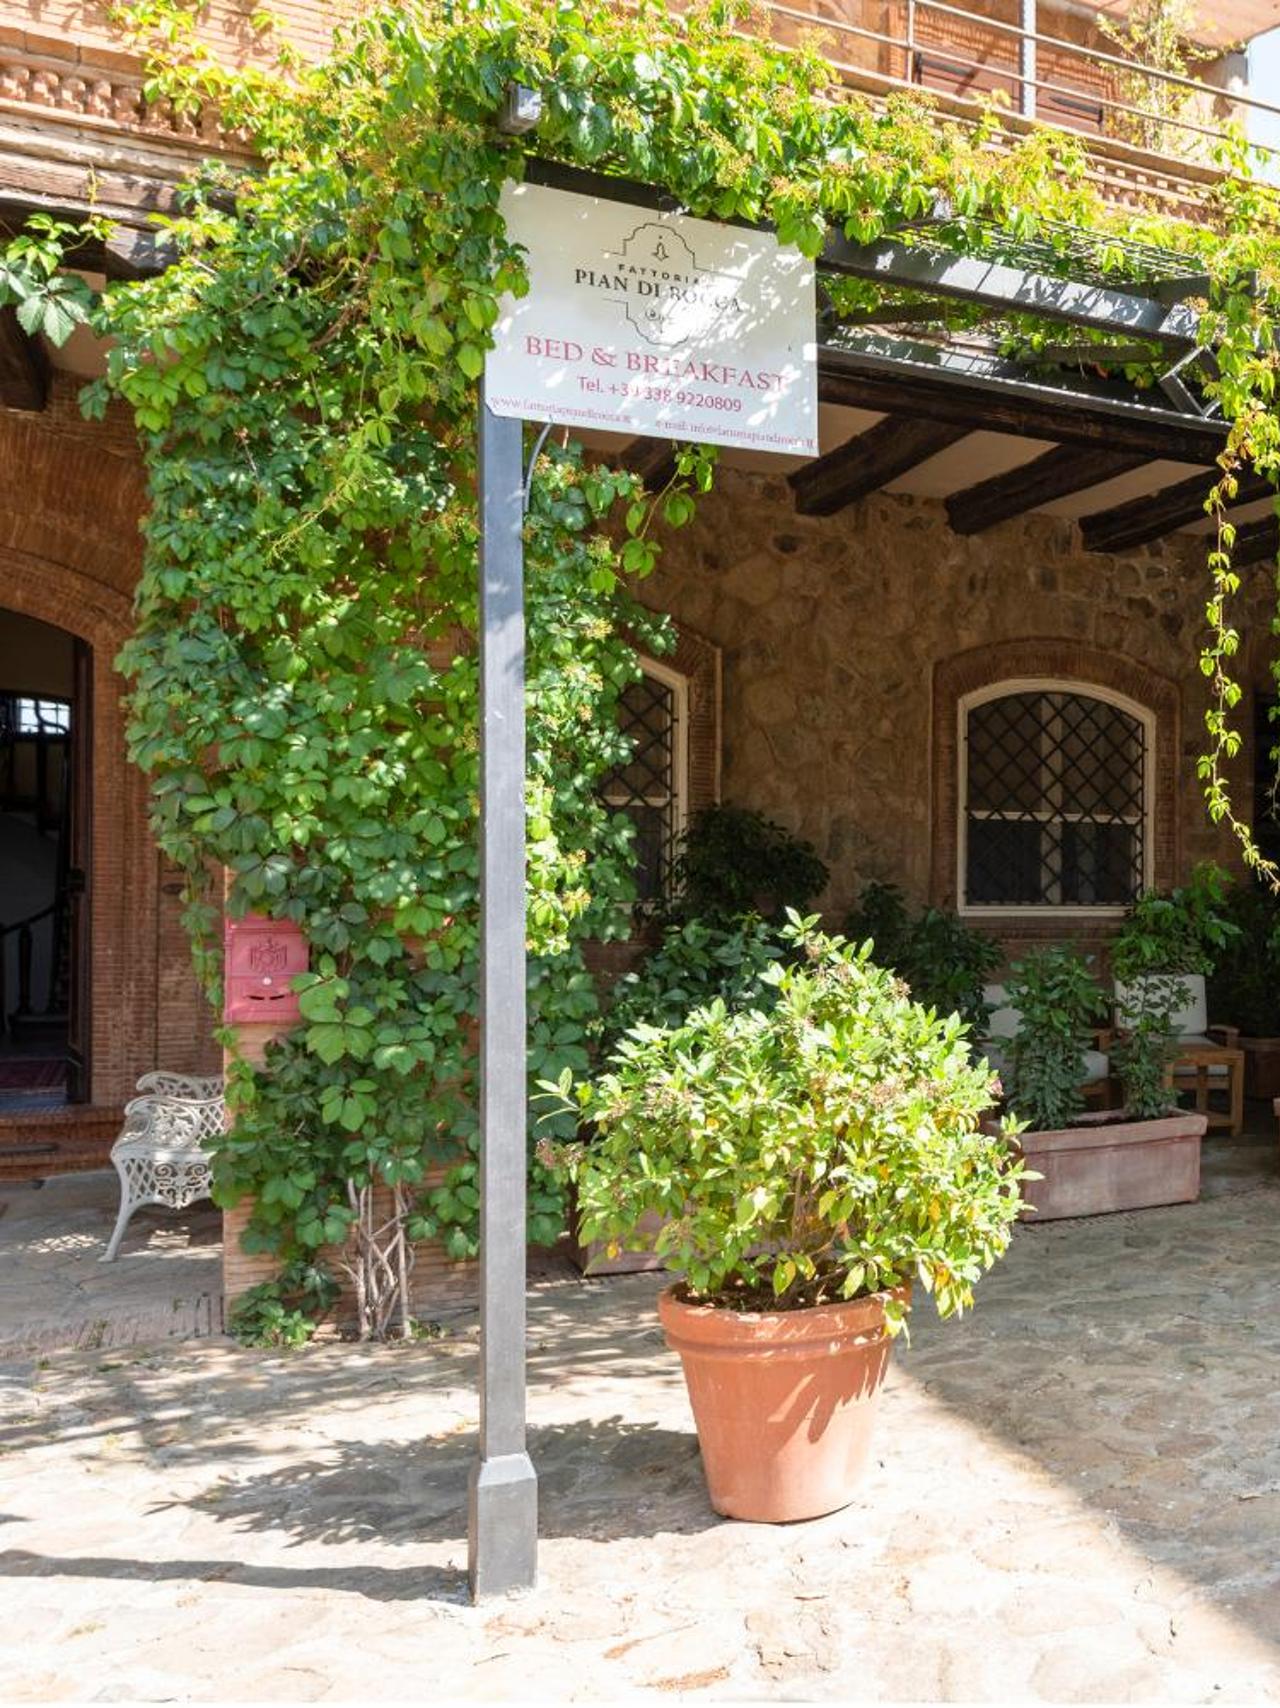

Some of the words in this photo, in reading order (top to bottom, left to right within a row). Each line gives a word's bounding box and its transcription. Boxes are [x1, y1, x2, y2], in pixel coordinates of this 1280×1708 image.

[575, 268, 628, 293] PIAN
[637, 280, 660, 298] DI
[670, 286, 743, 313] ROCA
[525, 335, 583, 362] BED
[591, 347, 617, 368] &
[626, 351, 789, 393] BREAKFAST
[577, 376, 603, 393] Tel.
[676, 391, 742, 412] 9220809
